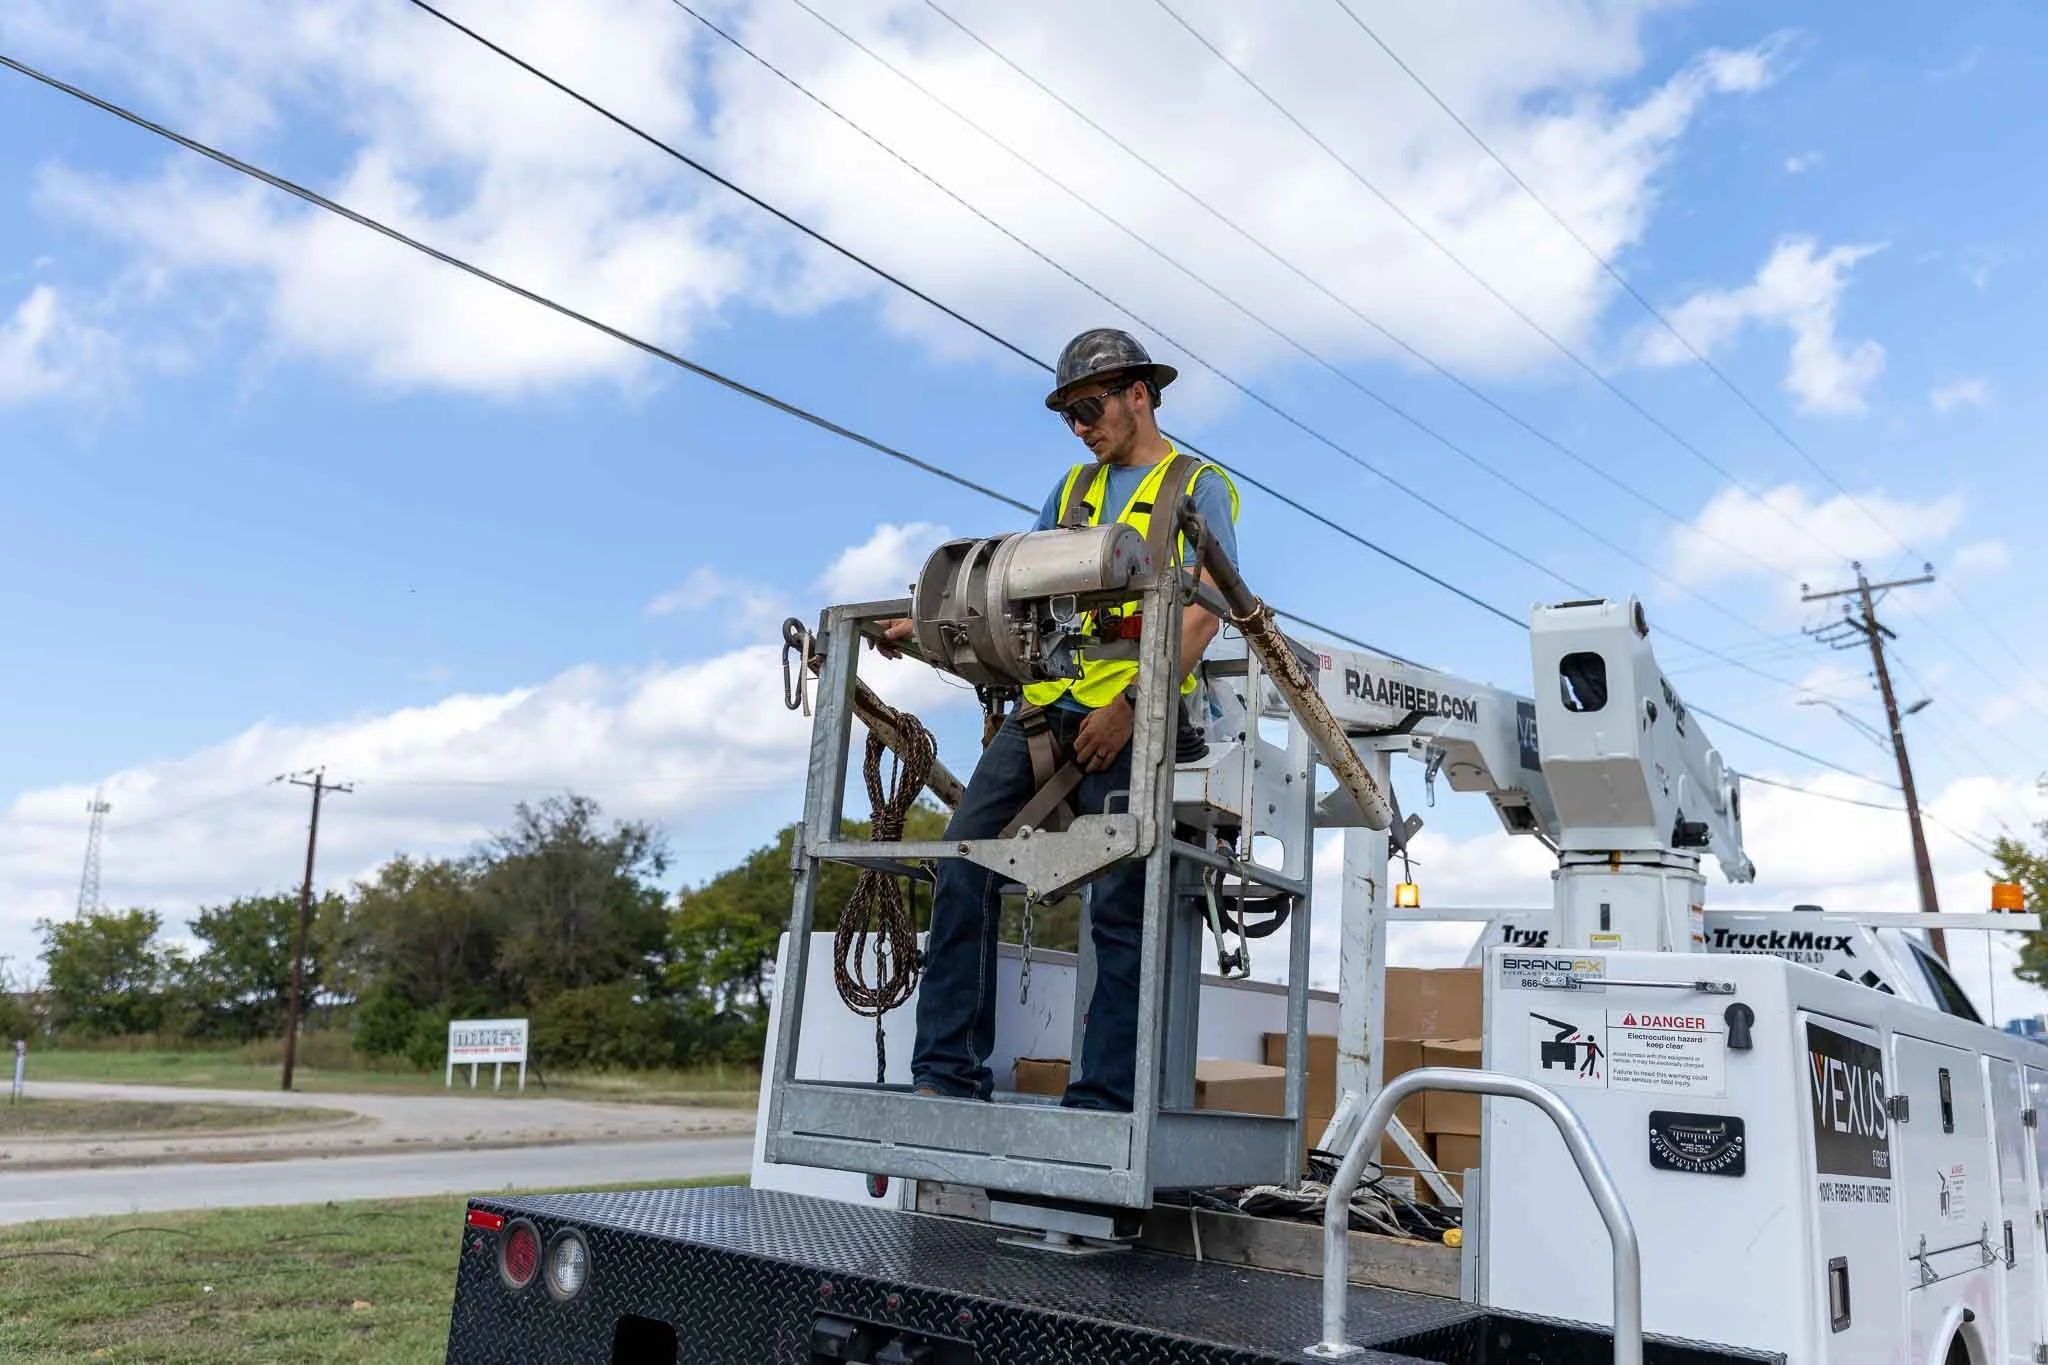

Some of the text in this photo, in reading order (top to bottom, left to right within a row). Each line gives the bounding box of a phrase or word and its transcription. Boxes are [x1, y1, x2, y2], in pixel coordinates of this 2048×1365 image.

[1344, 668, 1479, 724] RAAFIBER.COM
[1713, 928, 1857, 958] TruckMax
[1641, 1015, 1705, 1029] DANGER
[1627, 1033, 1676, 1042] Electrocution
[1646, 1041, 1664, 1049] keep
[1809, 1051, 1887, 1140] VEXUS
